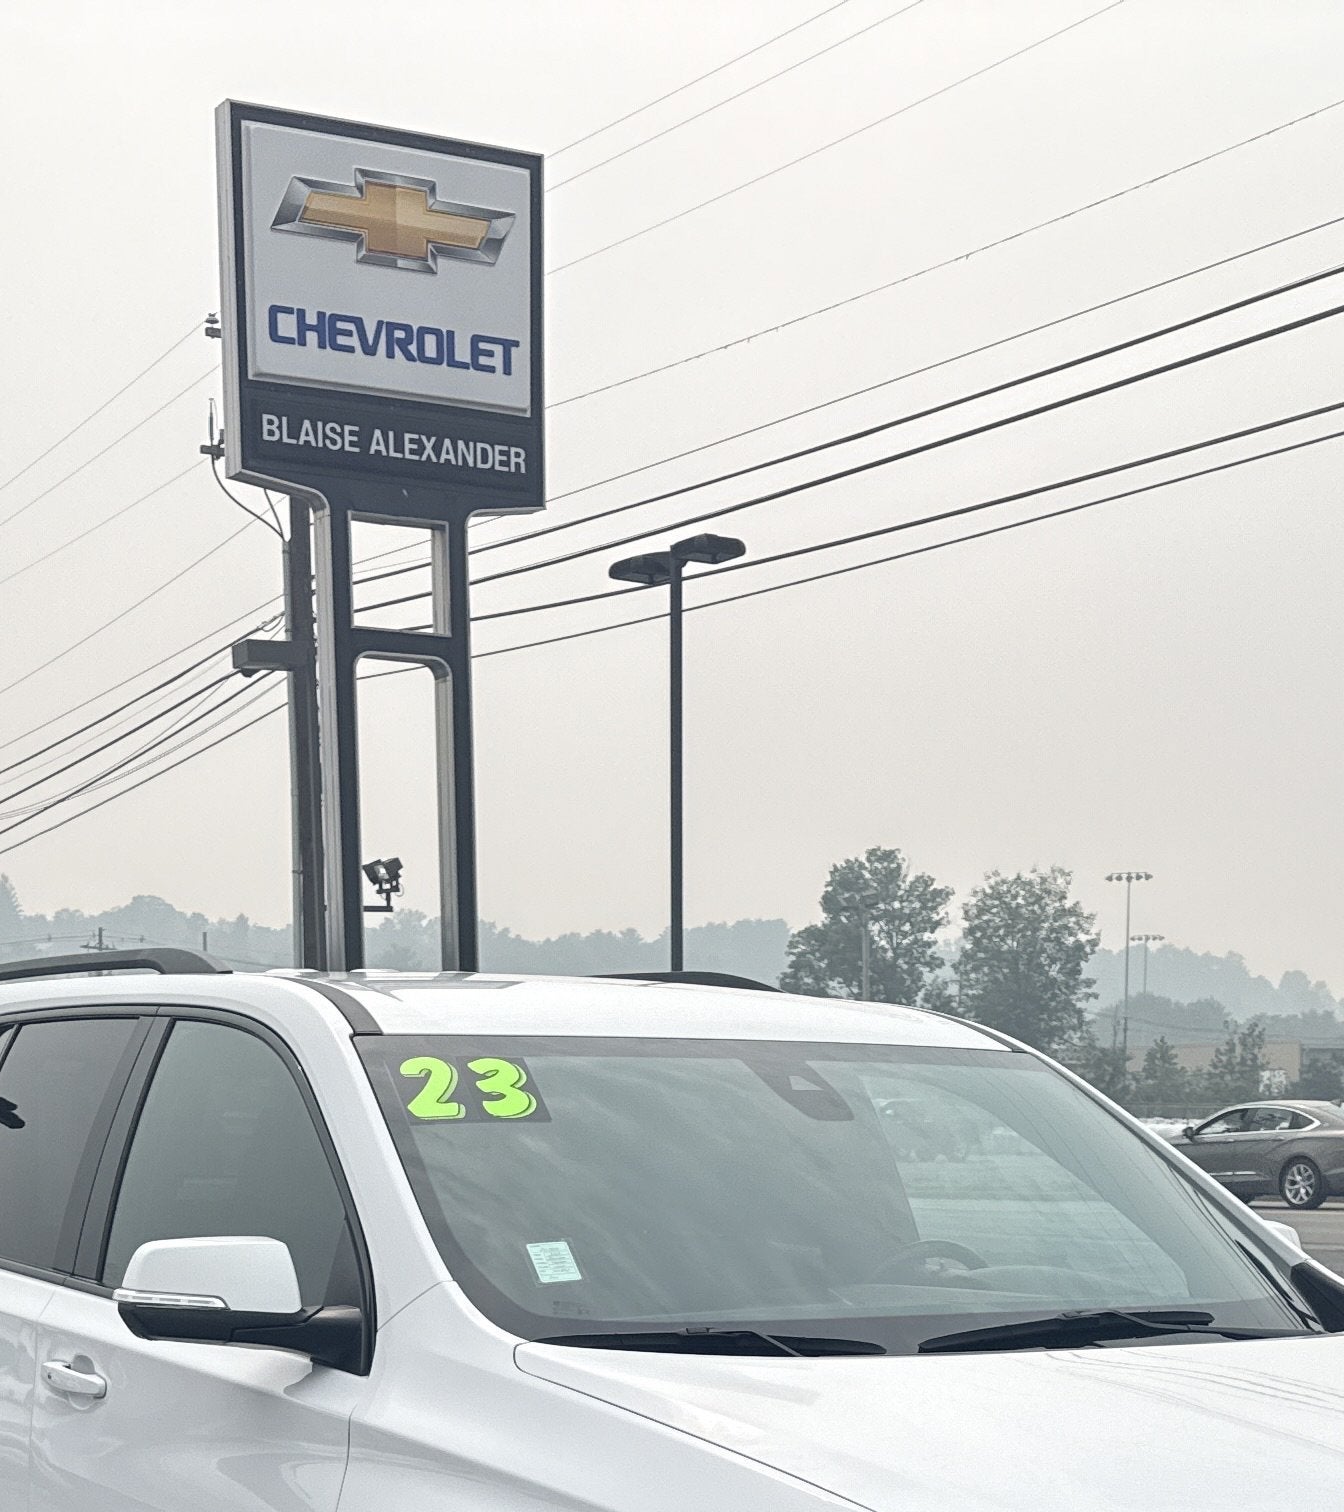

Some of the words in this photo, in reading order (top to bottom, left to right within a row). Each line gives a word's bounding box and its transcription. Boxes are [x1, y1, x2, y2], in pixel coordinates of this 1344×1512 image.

[268, 304, 520, 376] CHEVROLET
[261, 413, 360, 453] BLAISE
[369, 428, 526, 474] ALEXANDER
[399, 1056, 537, 1120] 23
